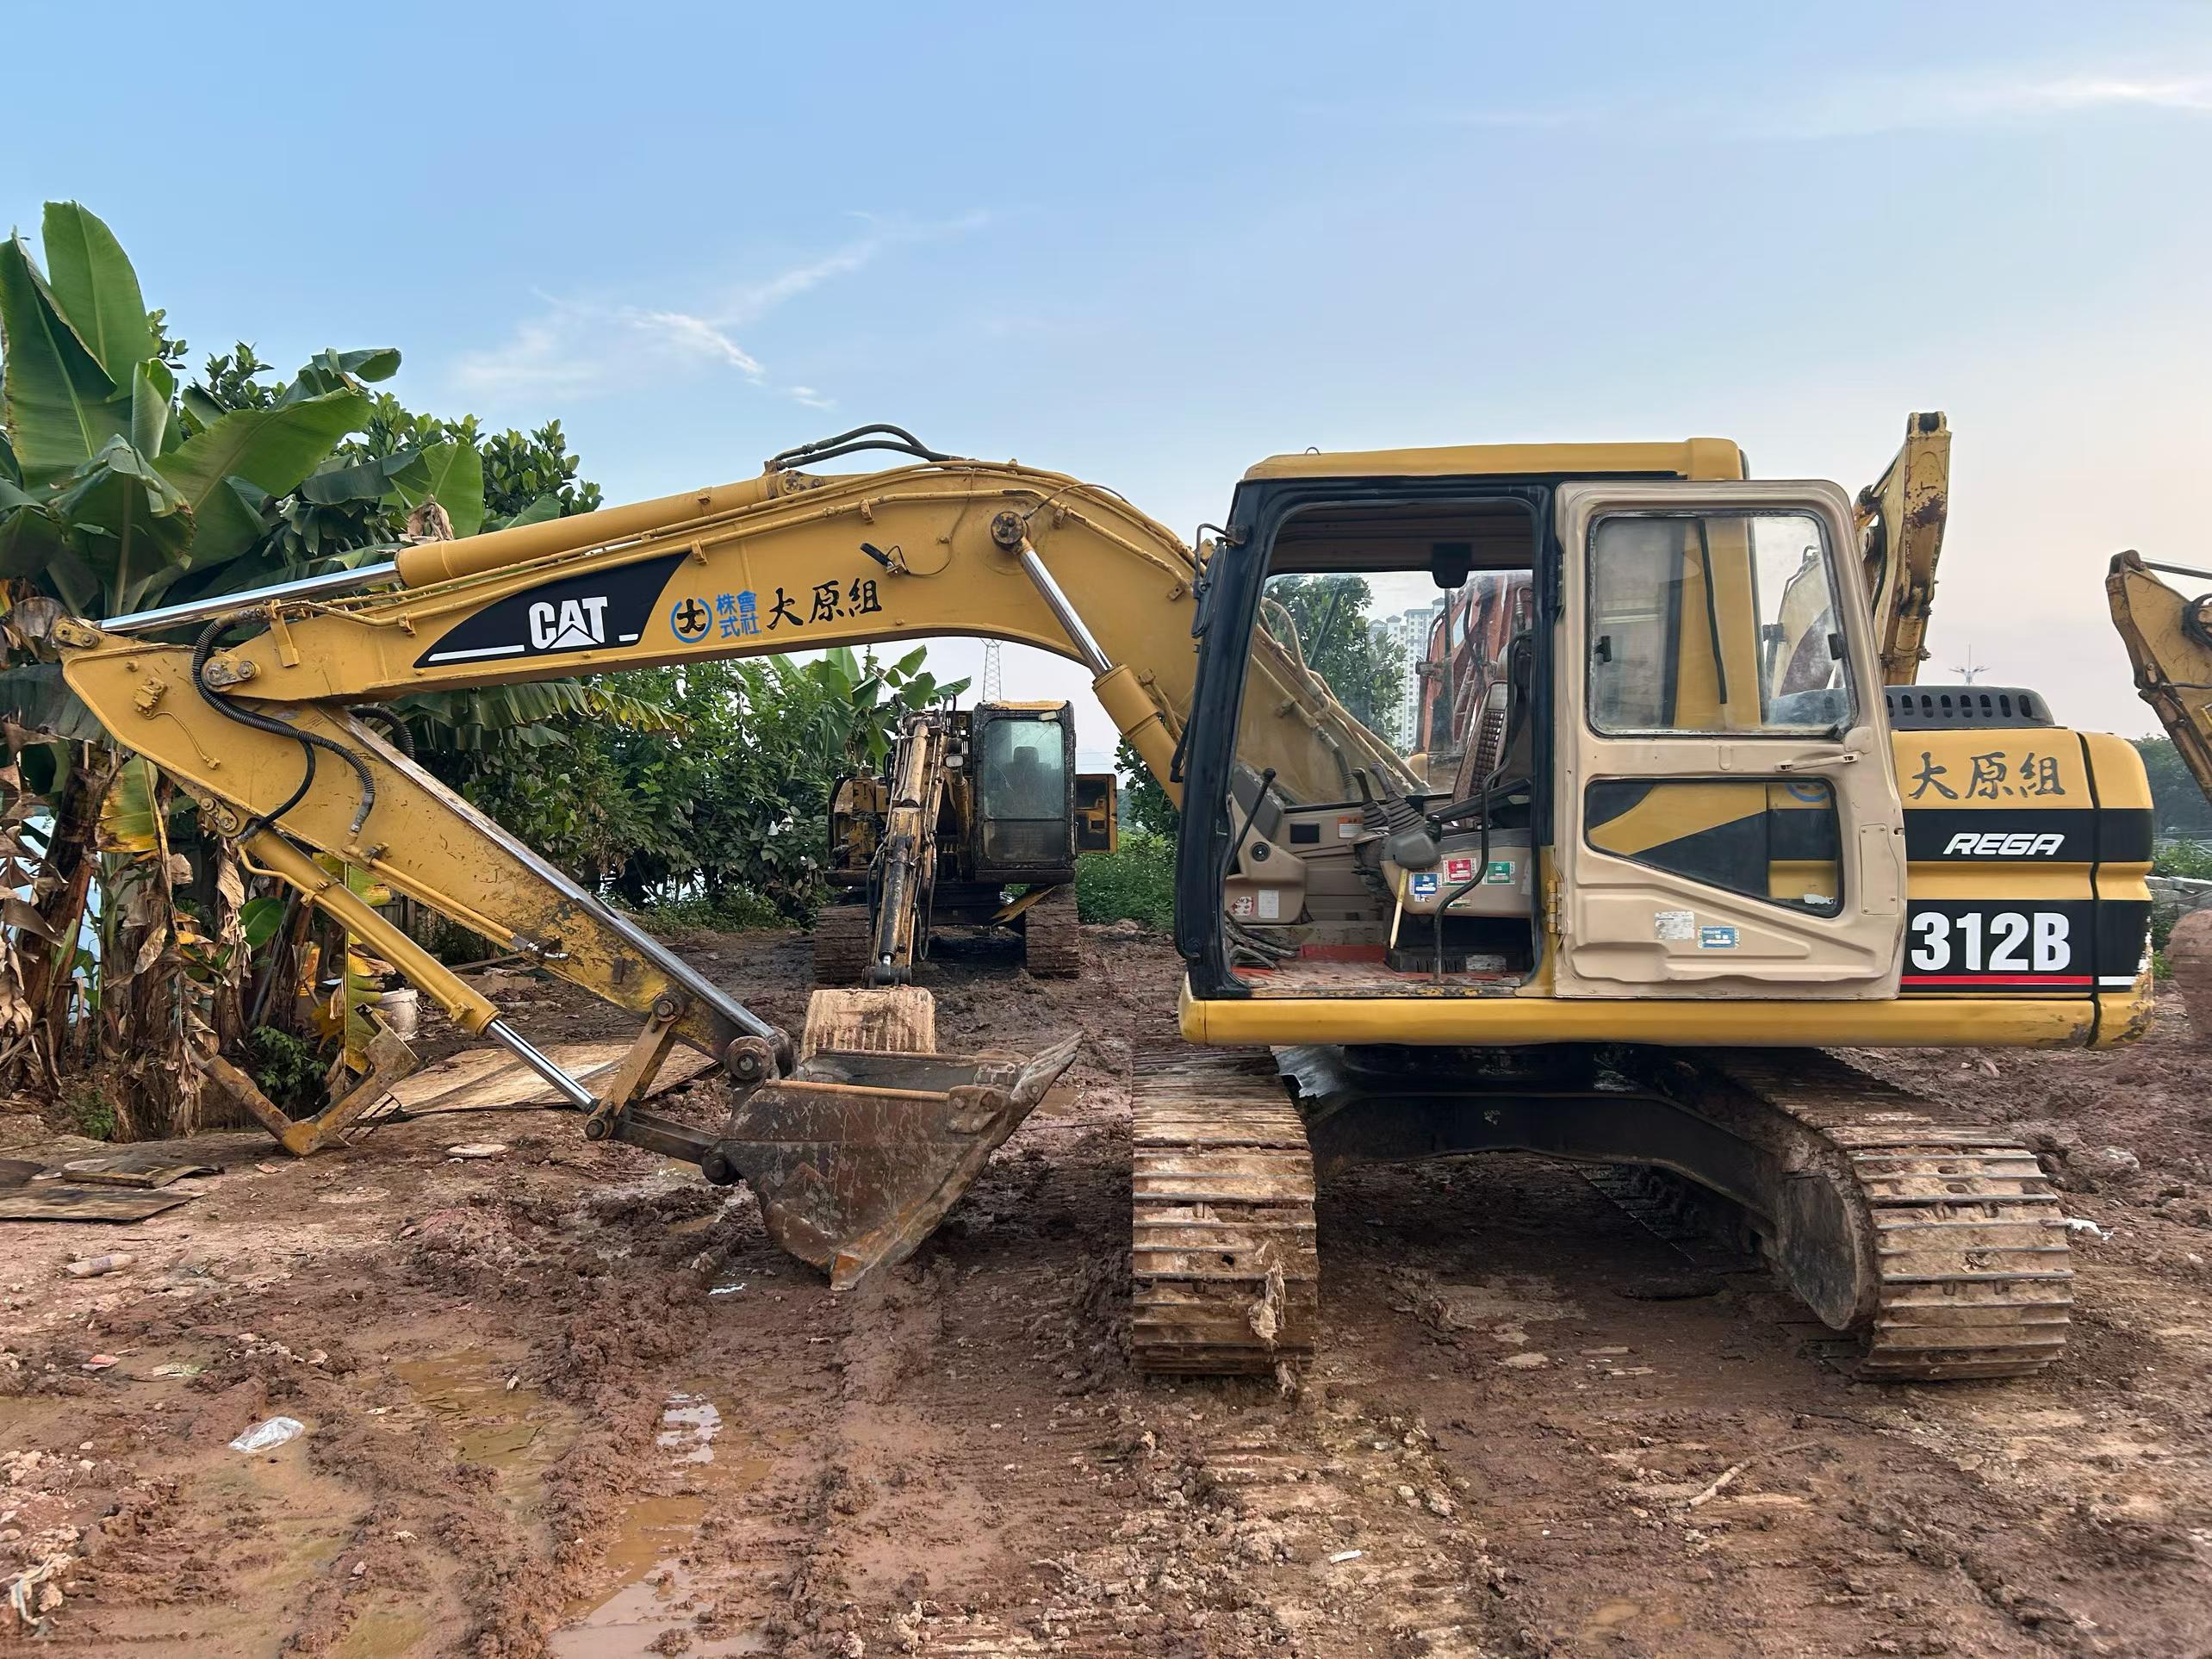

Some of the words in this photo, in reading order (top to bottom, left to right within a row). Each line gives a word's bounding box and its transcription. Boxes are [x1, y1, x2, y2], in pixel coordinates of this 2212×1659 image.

[528, 596, 608, 649] CAT
[766, 578, 882, 630] 大原組
[1908, 751, 2066, 800] 大原組
[1942, 832, 2066, 855] REGA
[1911, 911, 2071, 971] 312B
